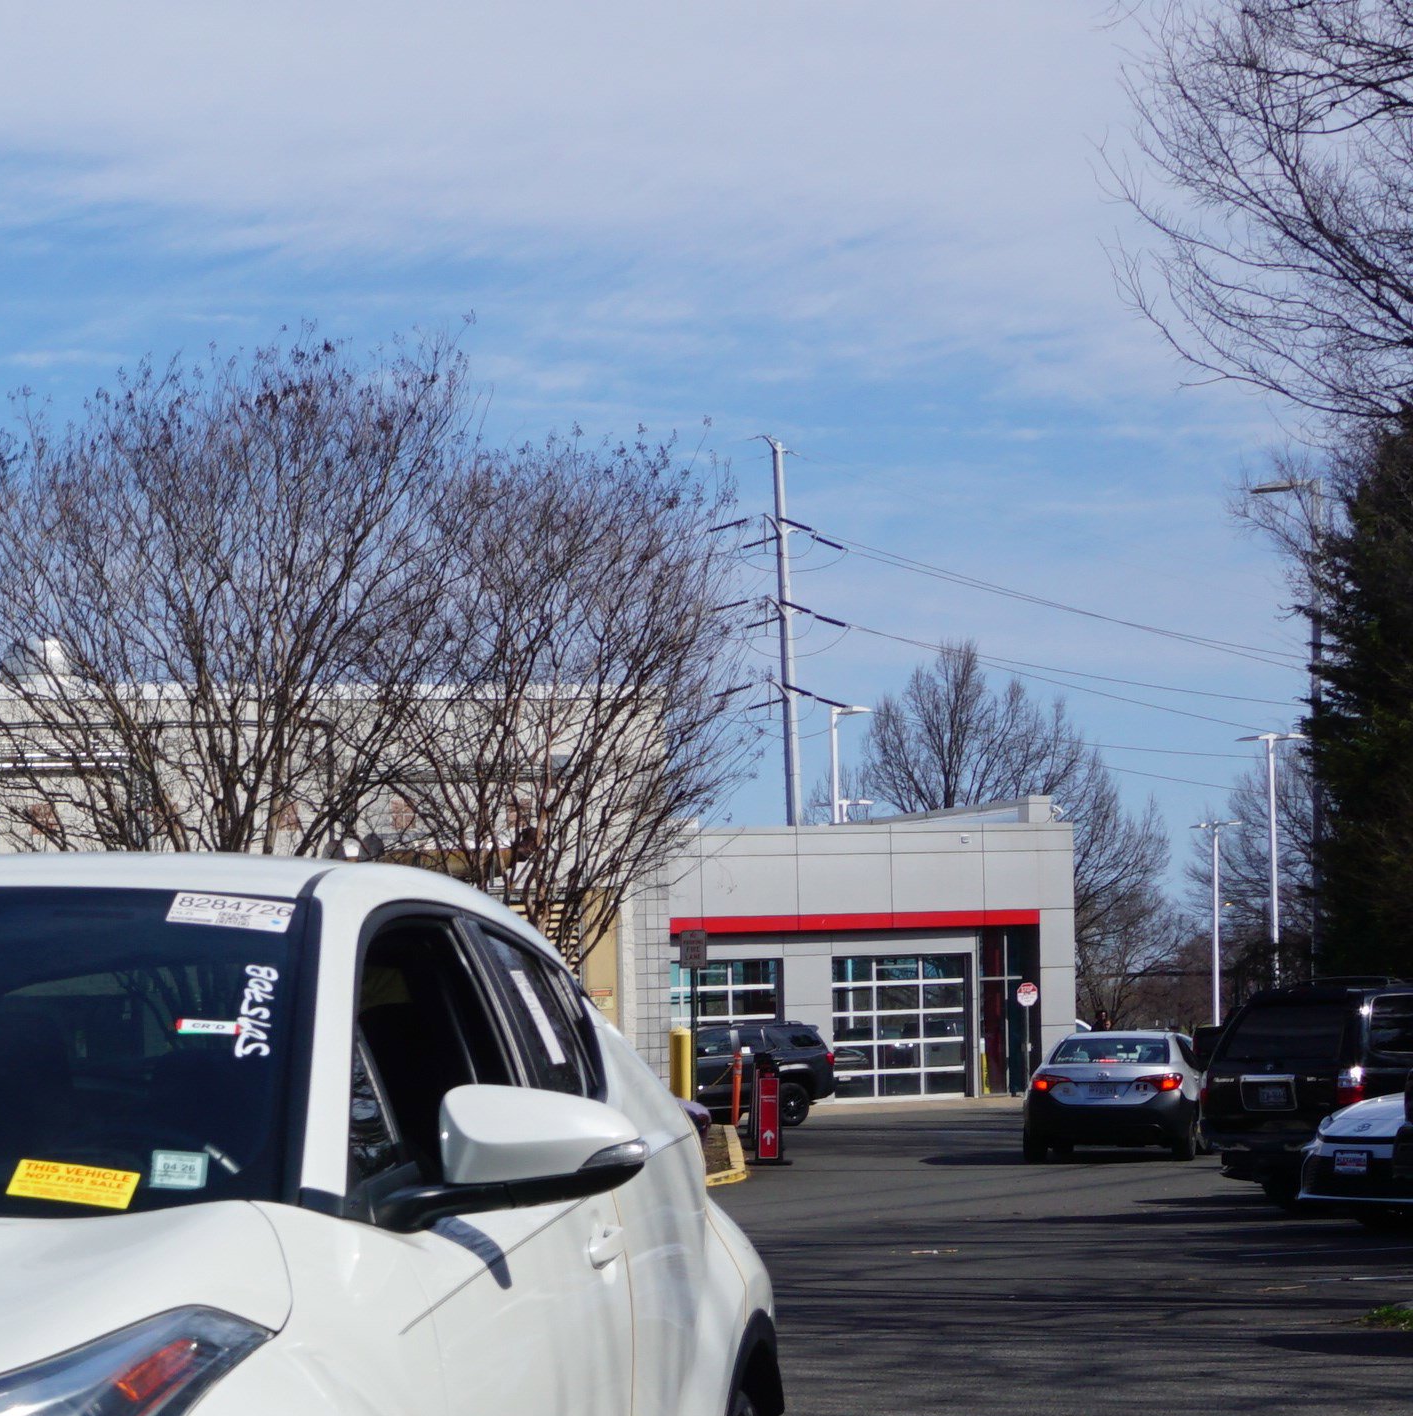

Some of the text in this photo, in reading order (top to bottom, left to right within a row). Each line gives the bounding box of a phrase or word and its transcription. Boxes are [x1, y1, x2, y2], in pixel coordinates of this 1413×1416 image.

[178, 896, 292, 917] 8284726
[24, 1172, 125, 1190] NOT FOR SALE
[25, 1162, 133, 1183] THIS VEHICLE
